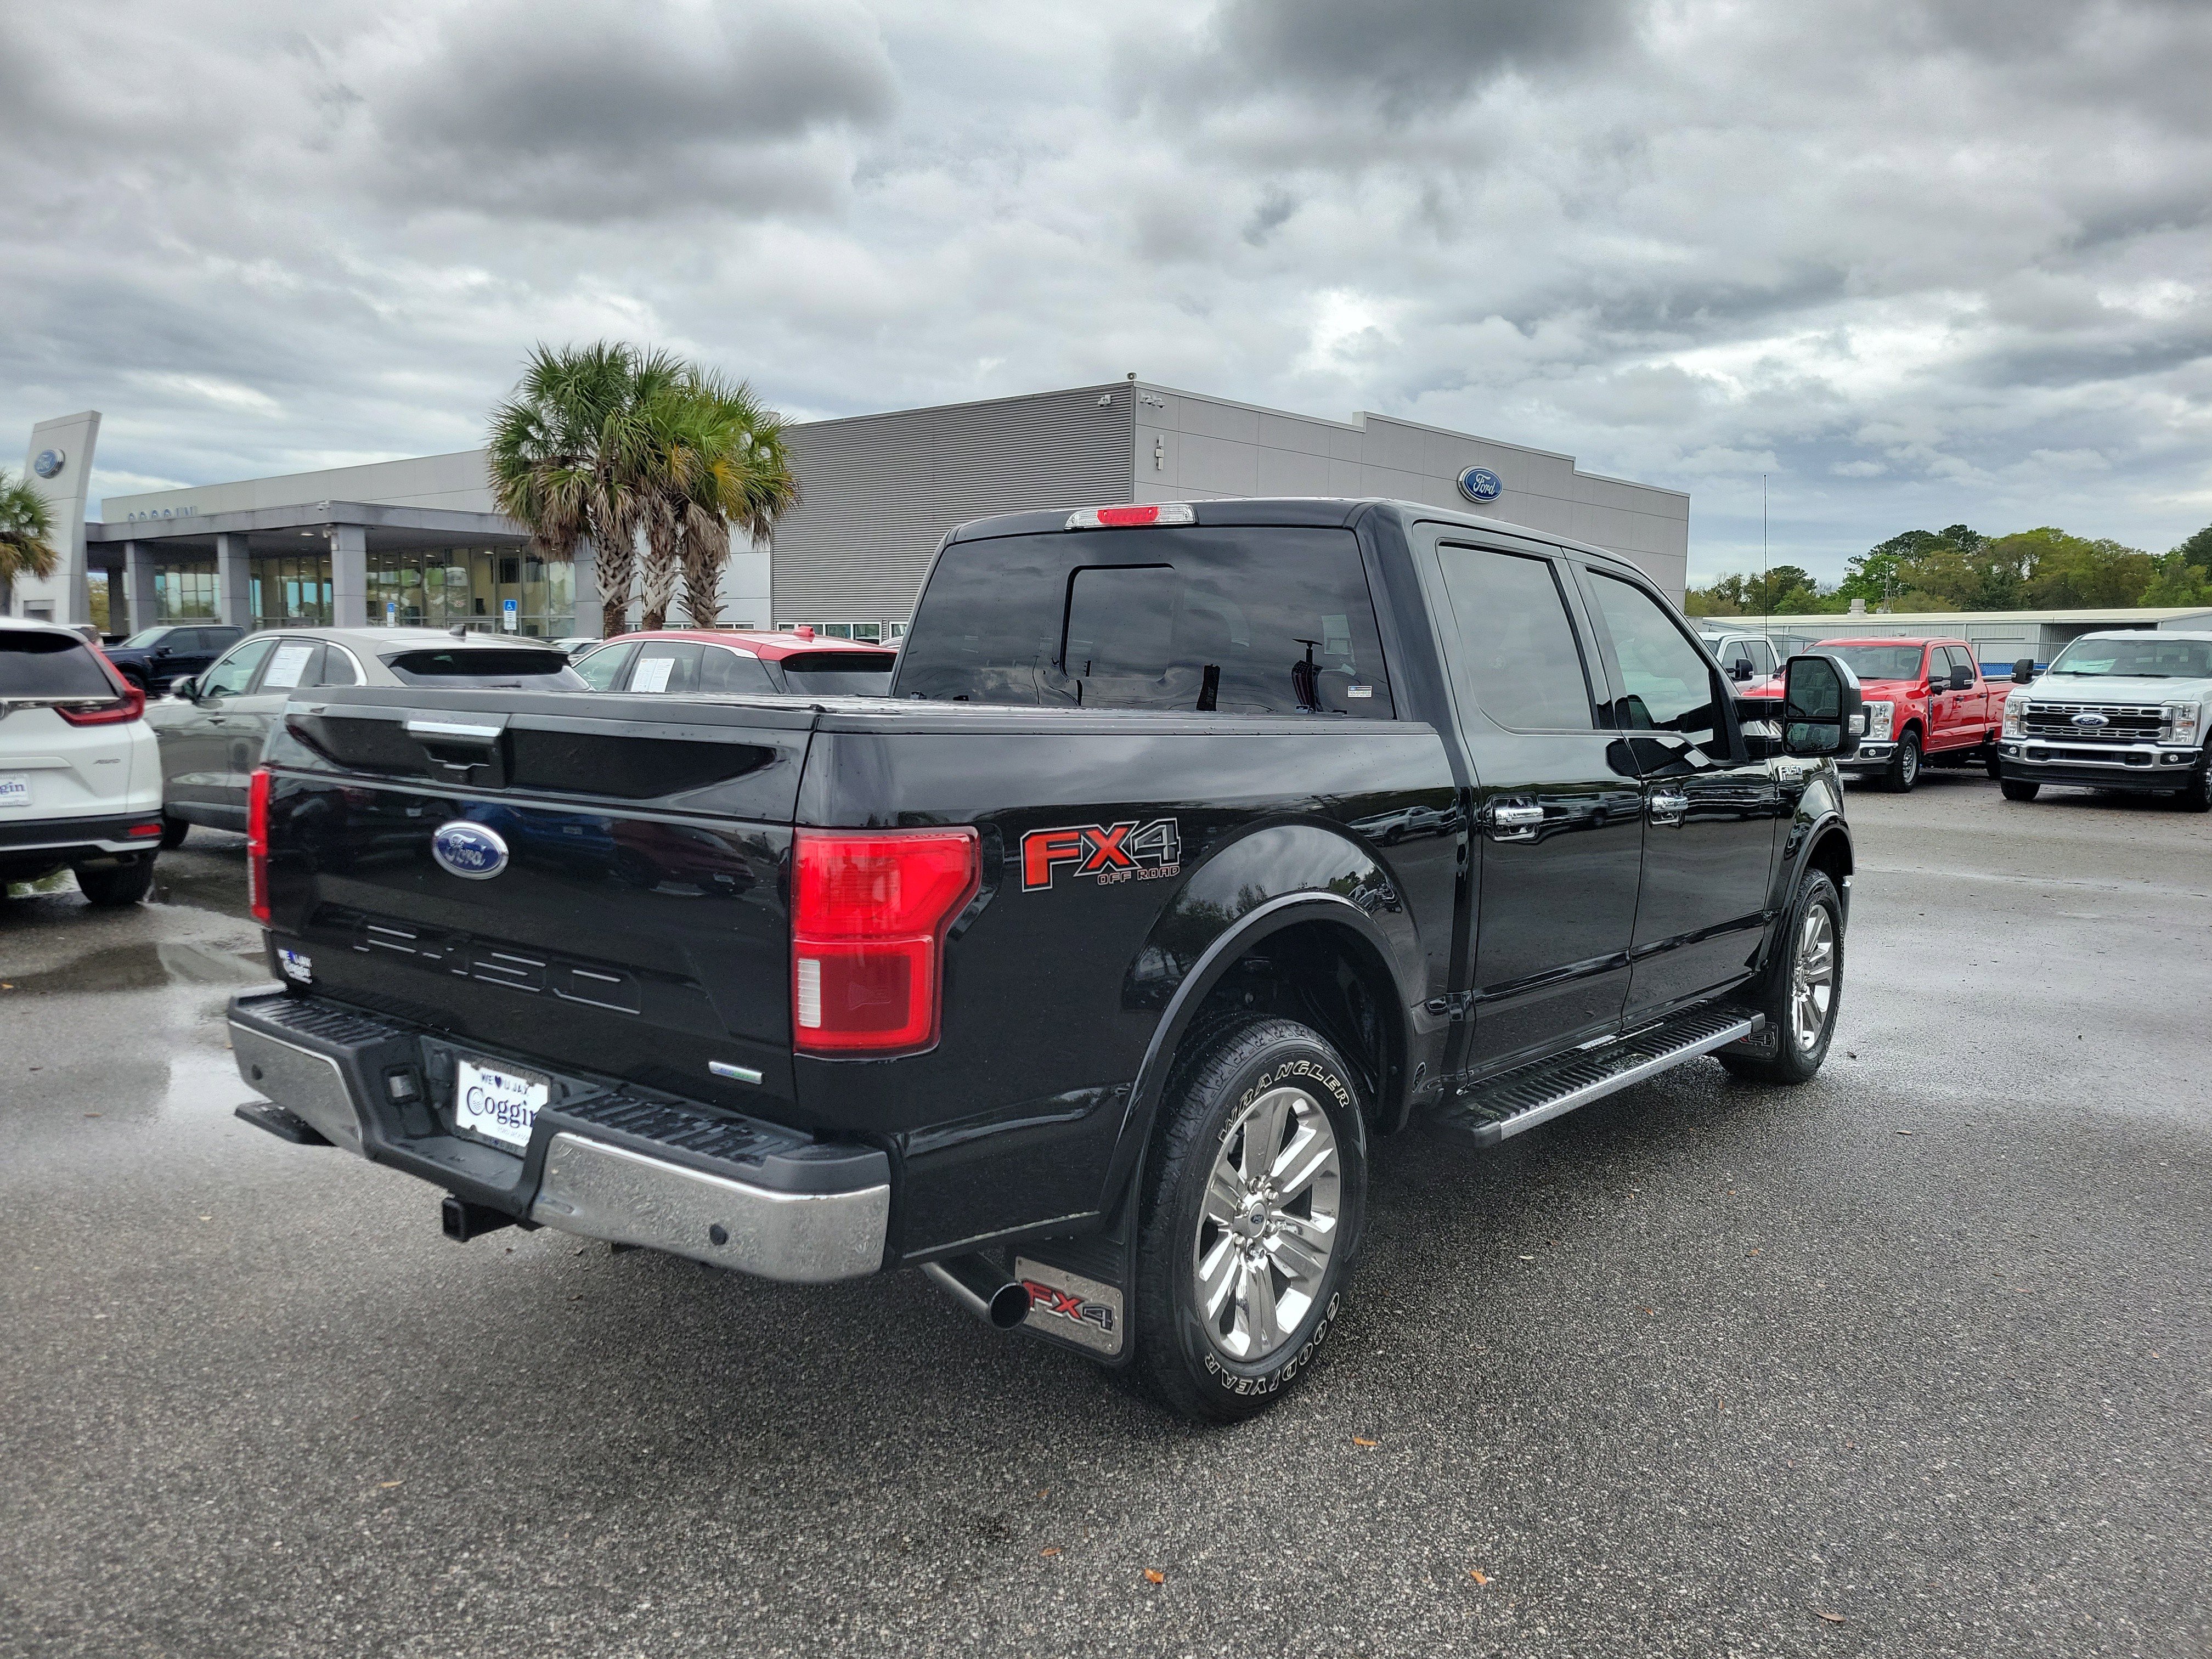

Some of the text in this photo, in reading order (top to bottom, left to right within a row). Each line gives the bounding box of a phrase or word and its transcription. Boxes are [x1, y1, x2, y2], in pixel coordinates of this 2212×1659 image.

[1473, 473, 1496, 495] Ford
[445, 833, 487, 866] Ford
[1020, 818, 1181, 892] FX4
[1098, 866, 1180, 885] OFF ROAD
[1217, 1060, 1350, 1143] WRANGLER
[1022, 1279, 1113, 1333] FX4
[1205, 1292, 1340, 1396] GOODYEAR
